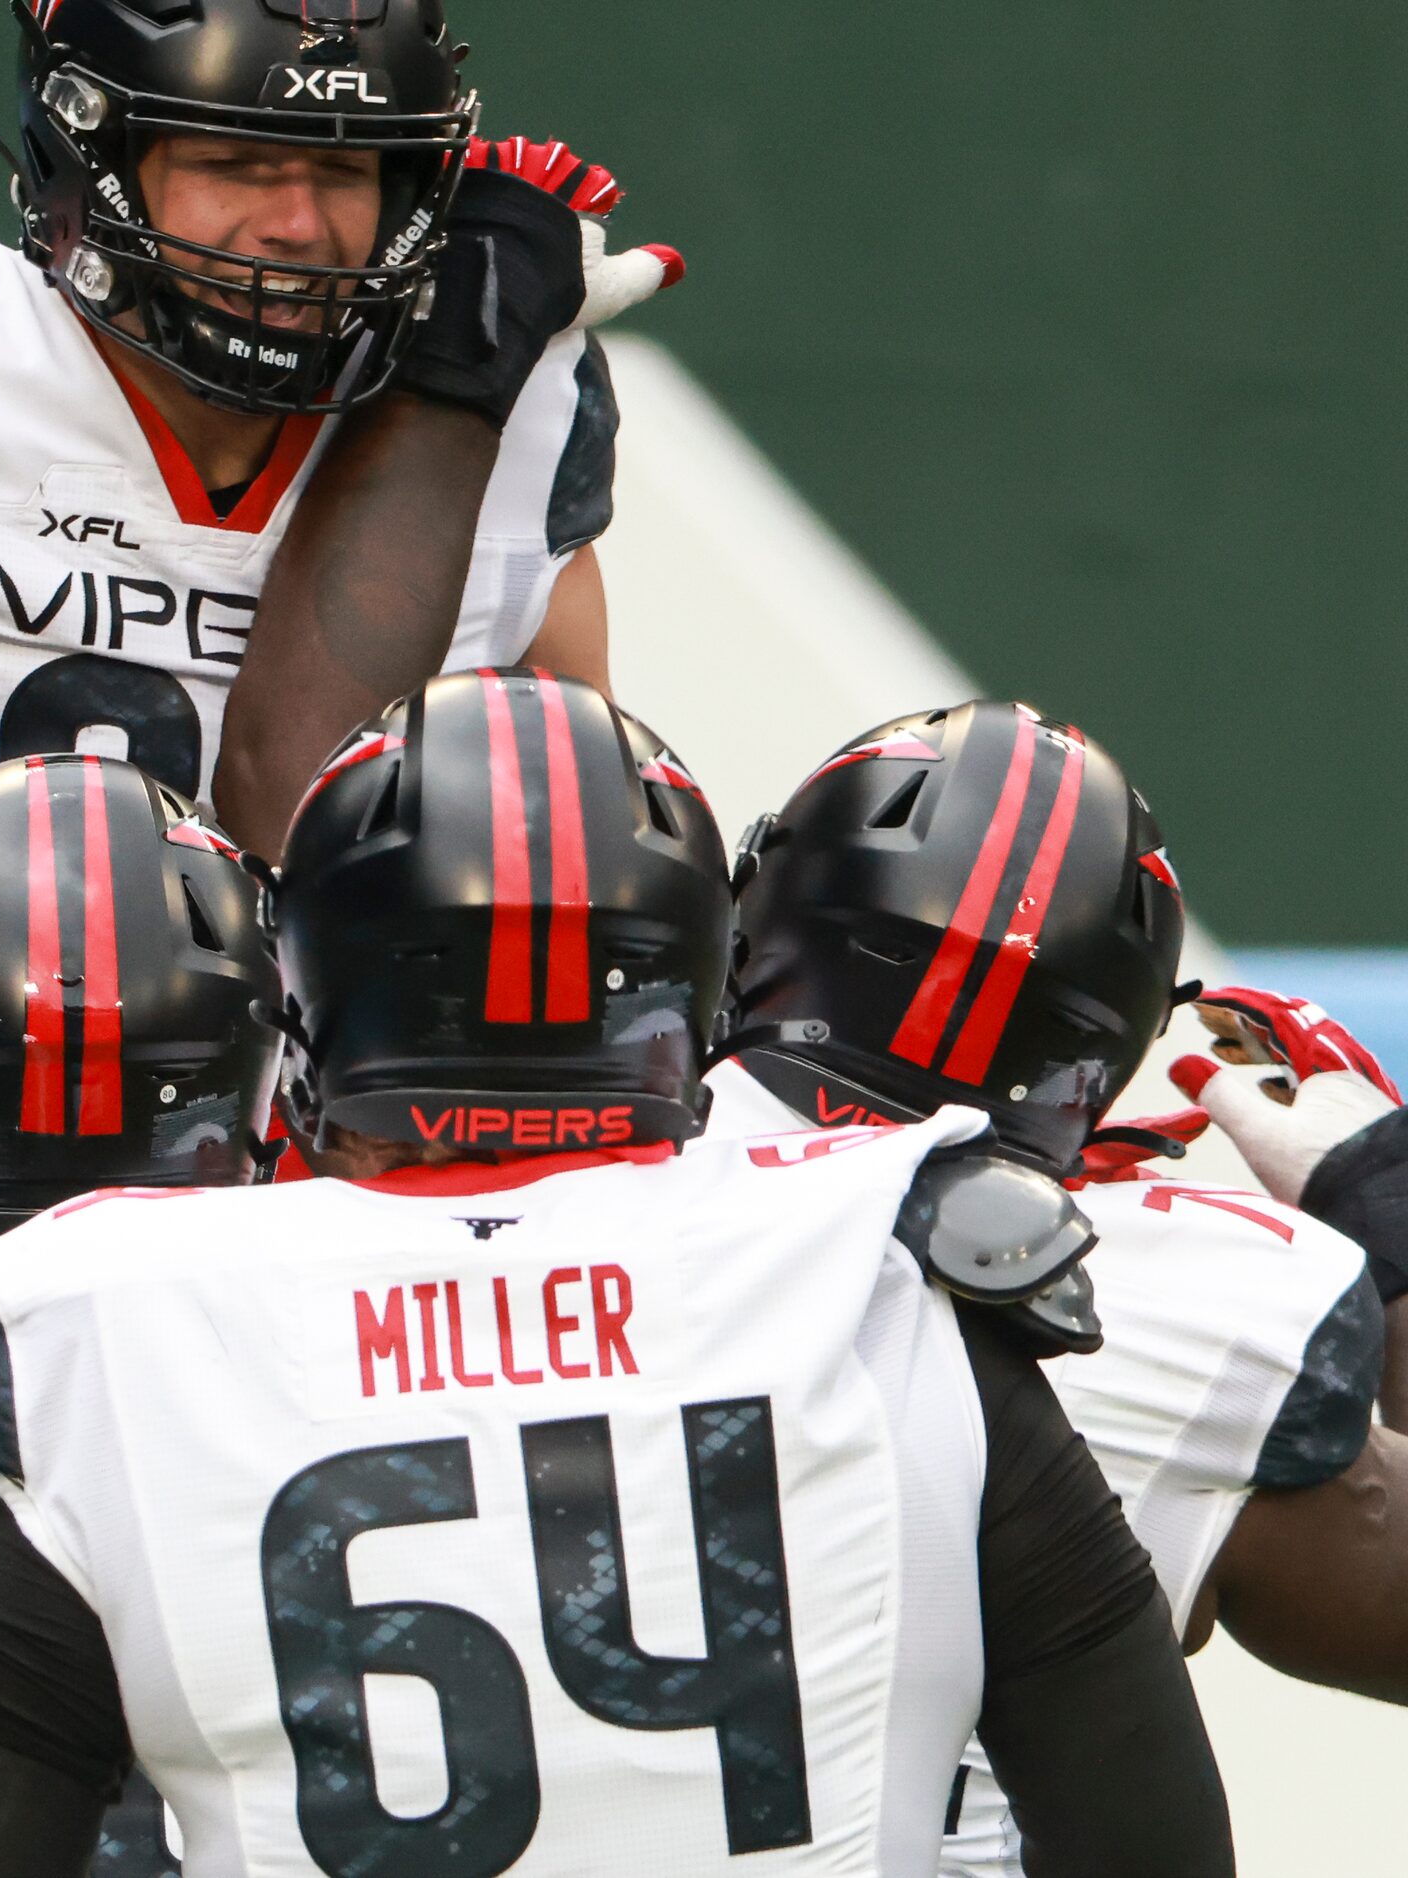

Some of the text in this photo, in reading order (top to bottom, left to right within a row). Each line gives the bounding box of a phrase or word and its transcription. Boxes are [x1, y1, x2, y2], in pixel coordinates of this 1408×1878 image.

[283, 68, 388, 104] XFL
[38, 508, 141, 551] XFL
[410, 1104, 633, 1146] VIPERS
[353, 1263, 640, 1398] MILLER
[260, 1395, 813, 1878] 64
